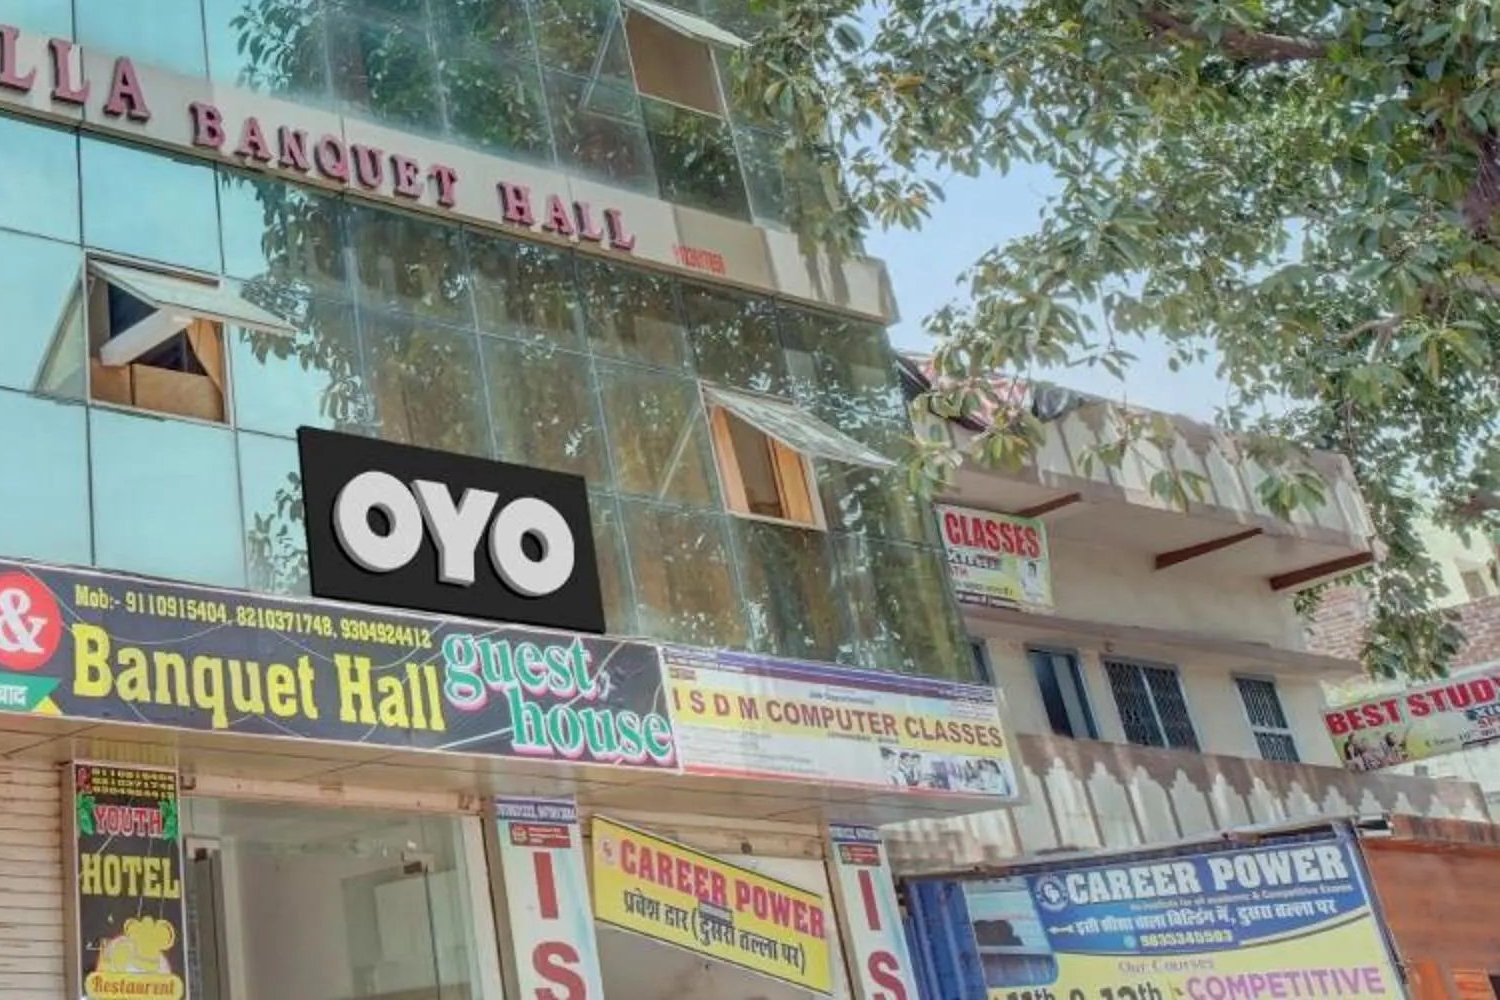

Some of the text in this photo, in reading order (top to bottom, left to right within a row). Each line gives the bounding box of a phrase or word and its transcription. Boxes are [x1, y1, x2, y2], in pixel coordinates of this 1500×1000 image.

[189, 101, 635, 250] BANQUET HALL
[333, 471, 575, 598] OYO
[944, 512, 1041, 558] CLASSES
[72, 623, 447, 732] Banquet Hall
[505, 685, 676, 767] house
[766, 700, 899, 737] COMPUTER
[904, 716, 1003, 748] CLASSES
[1325, 699, 1400, 736] BEST
[94, 805, 163, 837] YOUTH
[81, 853, 181, 899] HOTEL
[619, 838, 826, 940] CAREER POWER
[1066, 861, 1202, 905] CAREER
[1207, 846, 1349, 891] POWER
[1186, 966, 1387, 1000] COMPETITIVE
